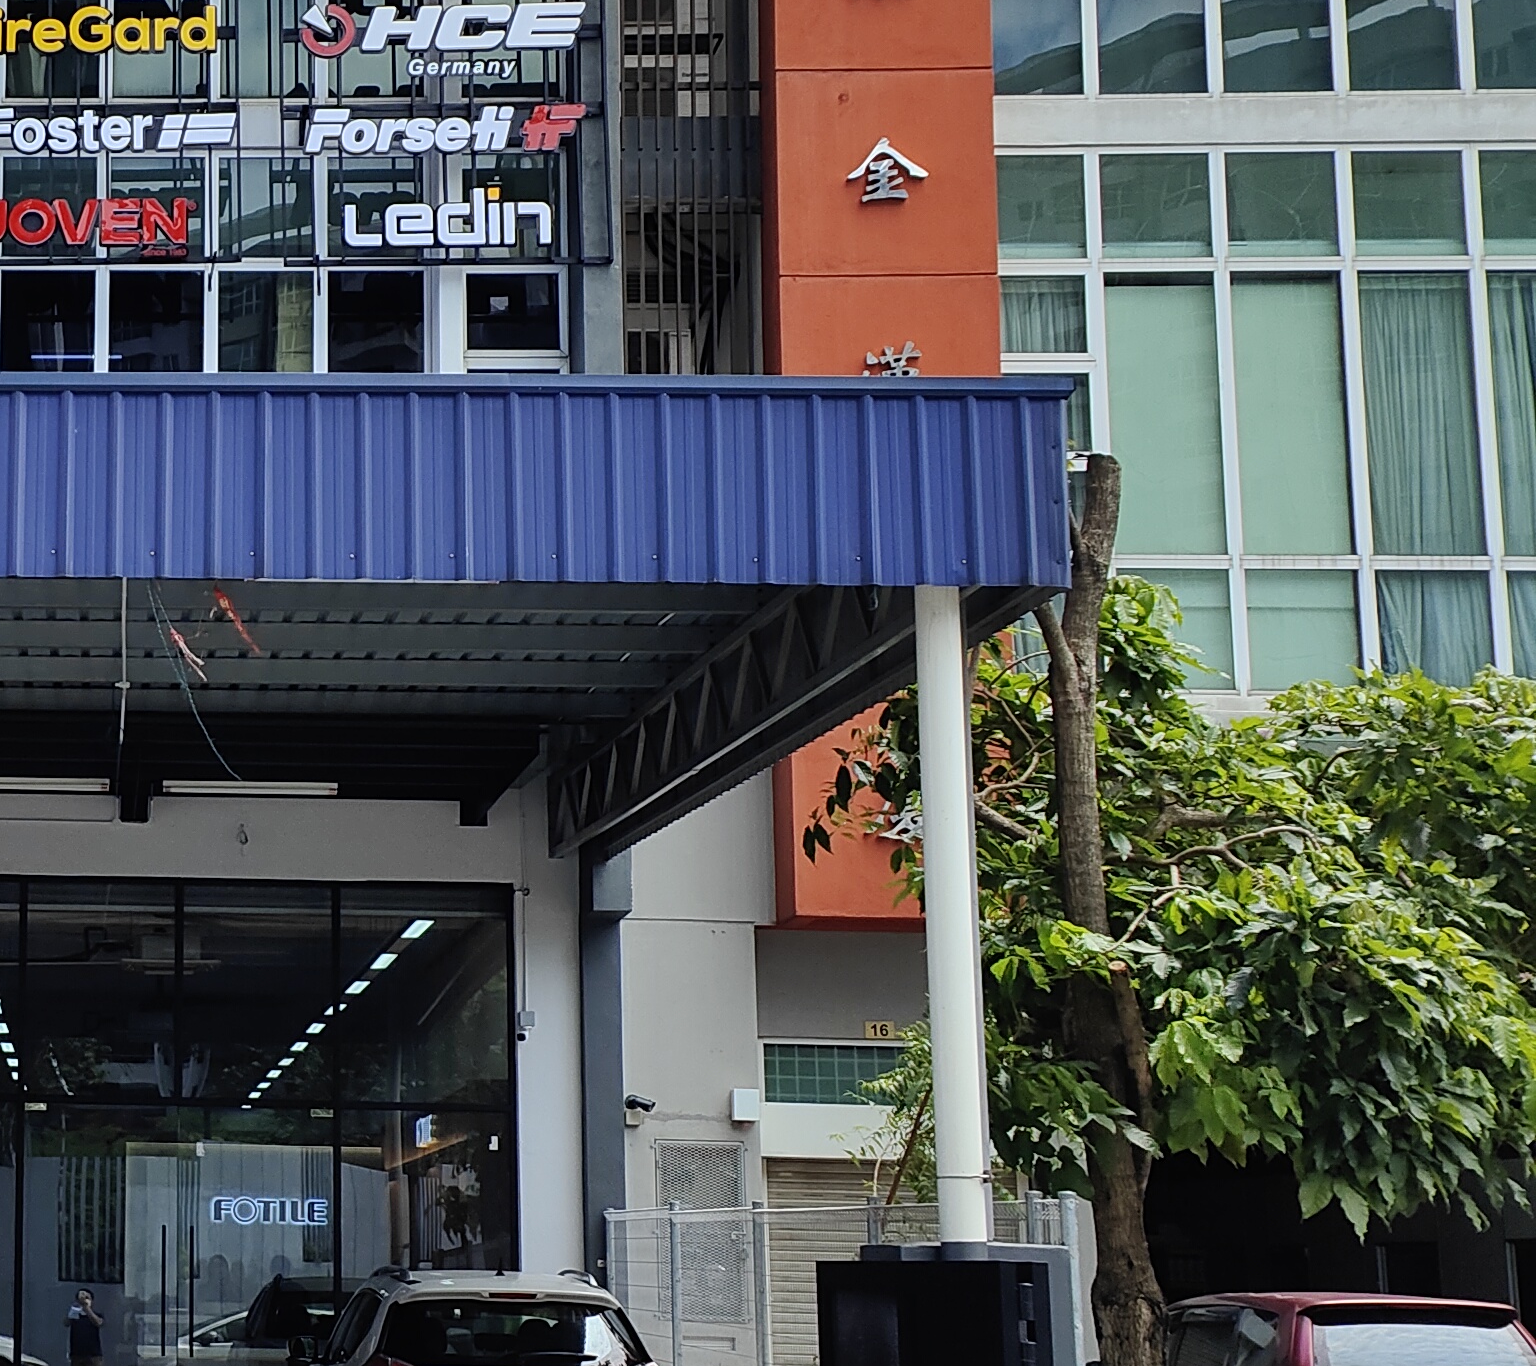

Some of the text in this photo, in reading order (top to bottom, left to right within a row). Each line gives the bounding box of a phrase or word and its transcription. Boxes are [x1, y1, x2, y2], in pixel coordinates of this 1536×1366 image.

[360, 1, 588, 53] HCE
[407, 58, 517, 79] Germany
[304, 106, 515, 154] Forseti
[870, 1023, 889, 1037] 16
[211, 1196, 328, 1225] FOTILE
